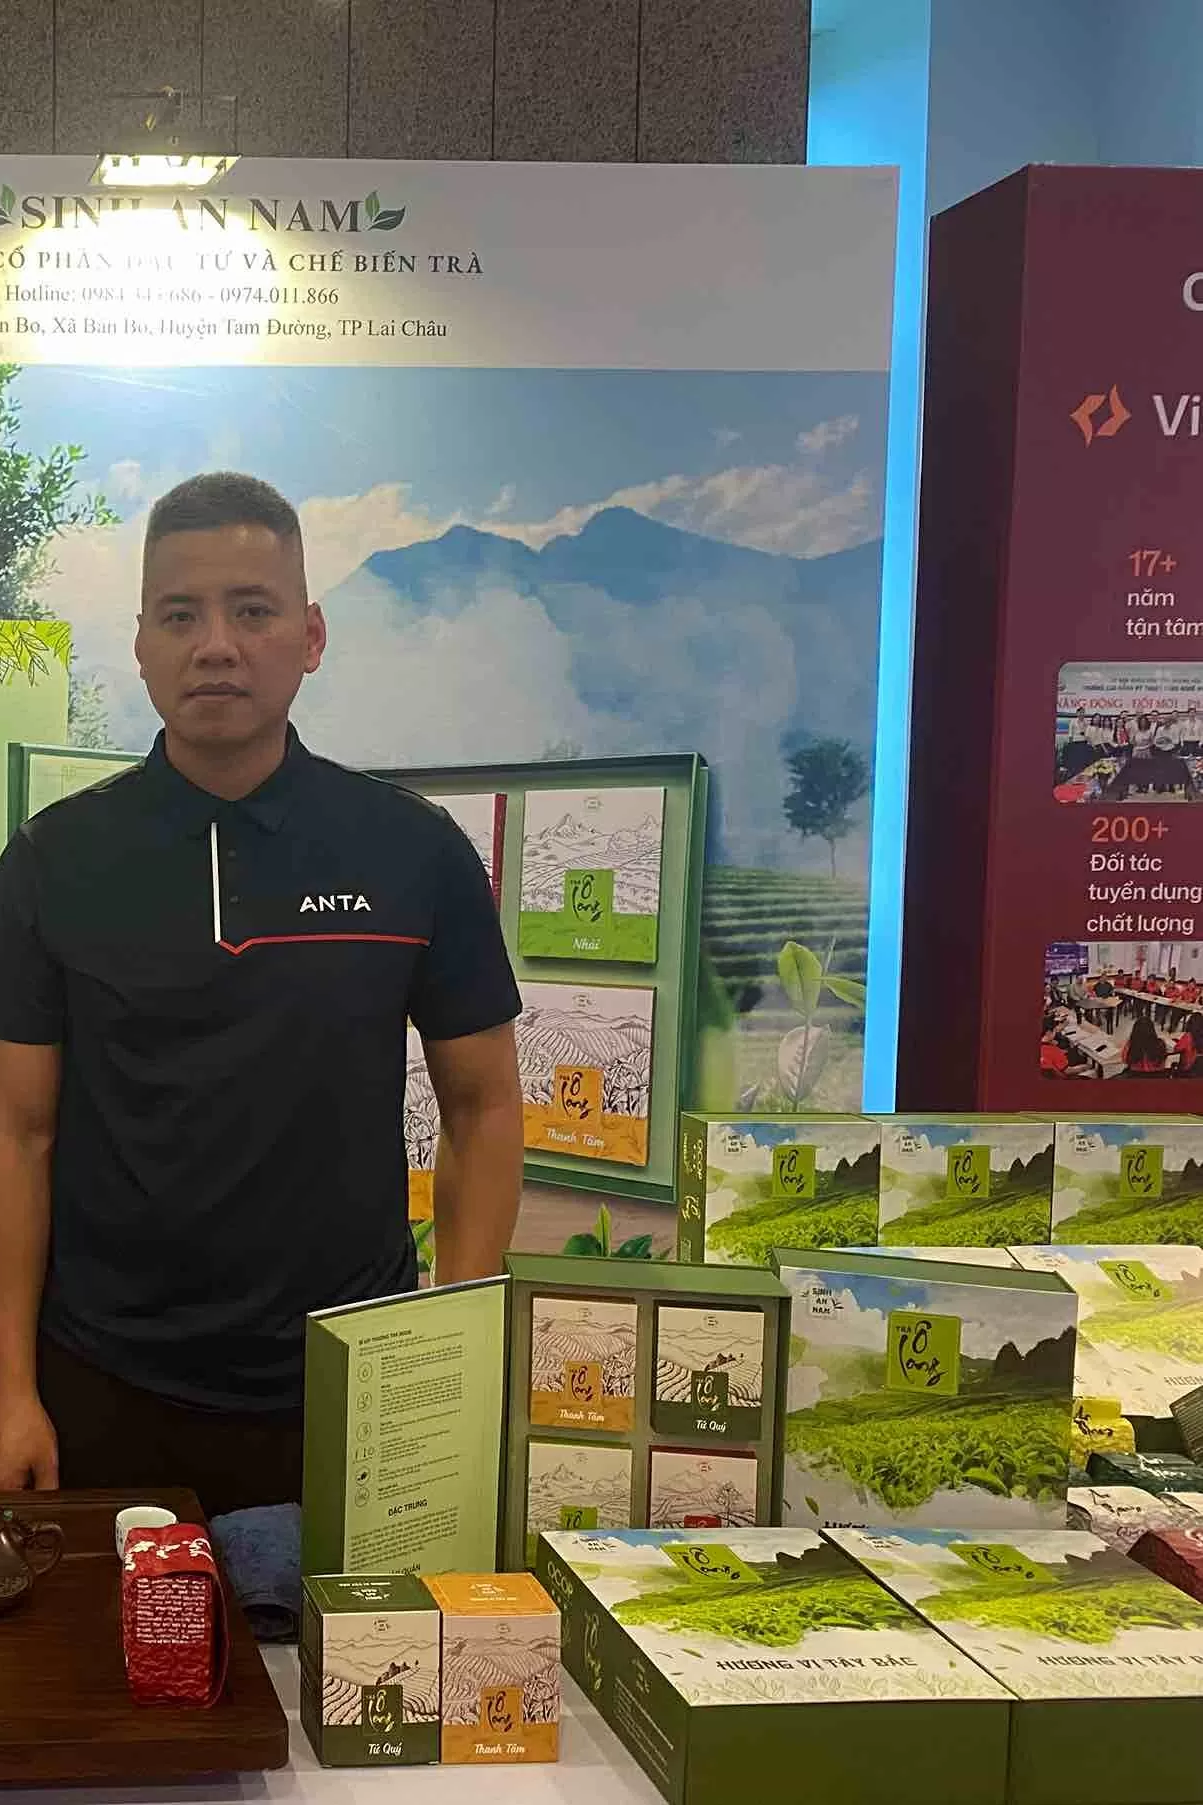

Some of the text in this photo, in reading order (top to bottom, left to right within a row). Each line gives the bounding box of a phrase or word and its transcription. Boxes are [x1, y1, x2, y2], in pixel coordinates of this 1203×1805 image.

[250, 199, 364, 232] NAM
[243, 249, 278, 271] VÀ
[288, 249, 344, 272] CHẾ
[354, 249, 417, 273] BIẾN
[428, 251, 485, 274] TRÀ
[6, 284, 76, 302] Hotline:
[220, 287, 340, 304] 0974.011.866
[16, 317, 46, 336] Bo,
[52, 317, 77, 334] Xã
[226, 318, 260, 335] Tam
[267, 318, 332, 340] Đường,
[339, 320, 363, 336] TP
[368, 319, 396, 336] Lai
[401, 319, 447, 337] Châu
[1128, 549, 1177, 577] 17+
[1127, 588, 1175, 607] năm
[1125, 618, 1203, 640] tận tâm
[1091, 816, 1170, 843] 200+
[1089, 851, 1163, 872] Đối tác
[1088, 880, 1203, 904] tuyển dụng
[299, 894, 373, 913] ANTA
[1086, 912, 1195, 935] chất lượng
[716, 1657, 796, 1671] HƯƠNG
[382, 1742, 403, 1756] Quý
[474, 1743, 525, 1754] Thanh Tâm
